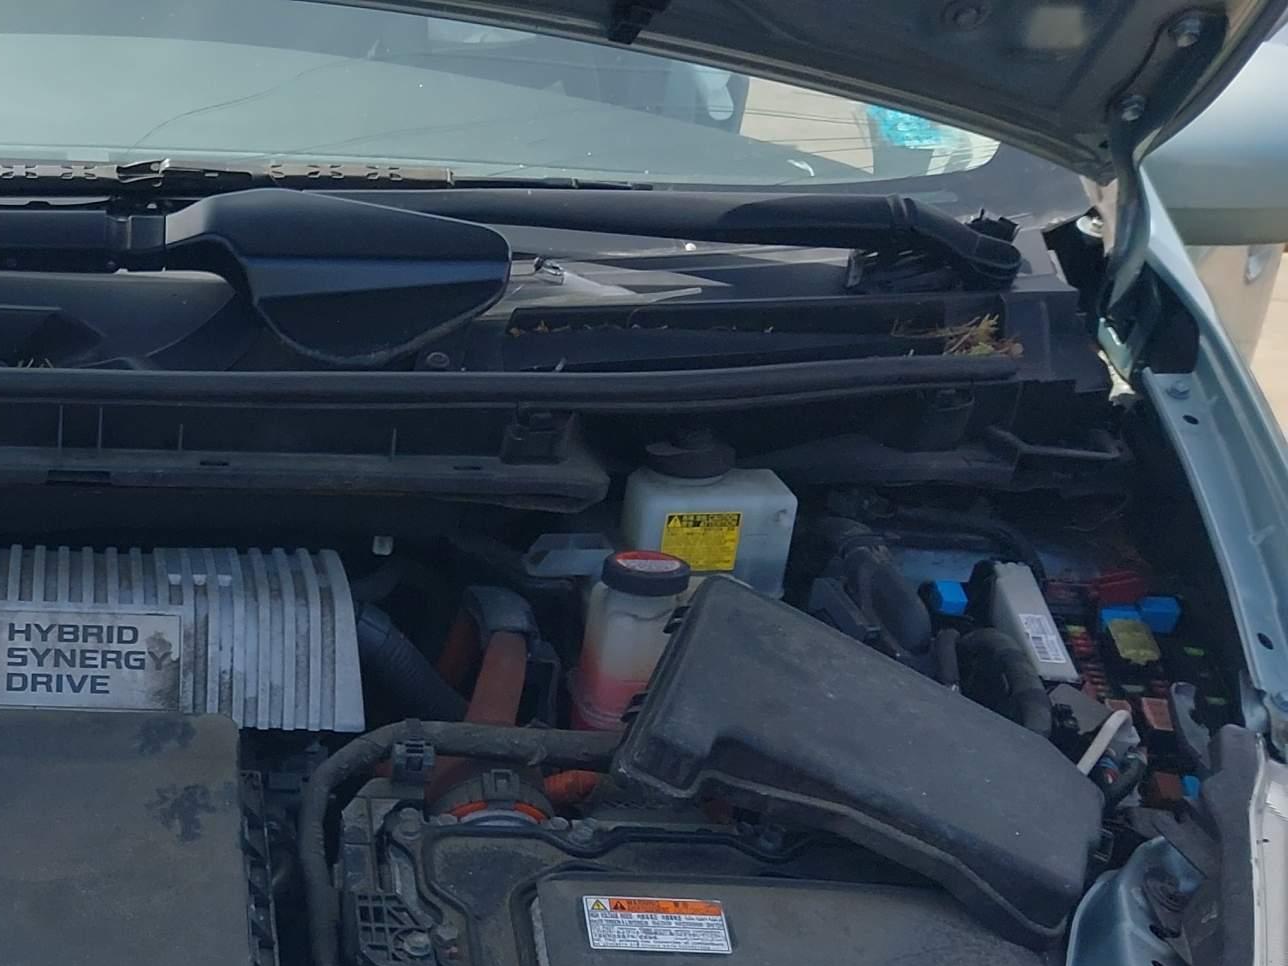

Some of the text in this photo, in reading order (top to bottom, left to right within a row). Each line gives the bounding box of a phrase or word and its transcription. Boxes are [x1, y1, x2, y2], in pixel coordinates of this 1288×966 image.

[8, 623, 139, 645] HYBRID
[7, 647, 172, 671] SYNERGY
[6, 672, 111, 694] DRIVE
